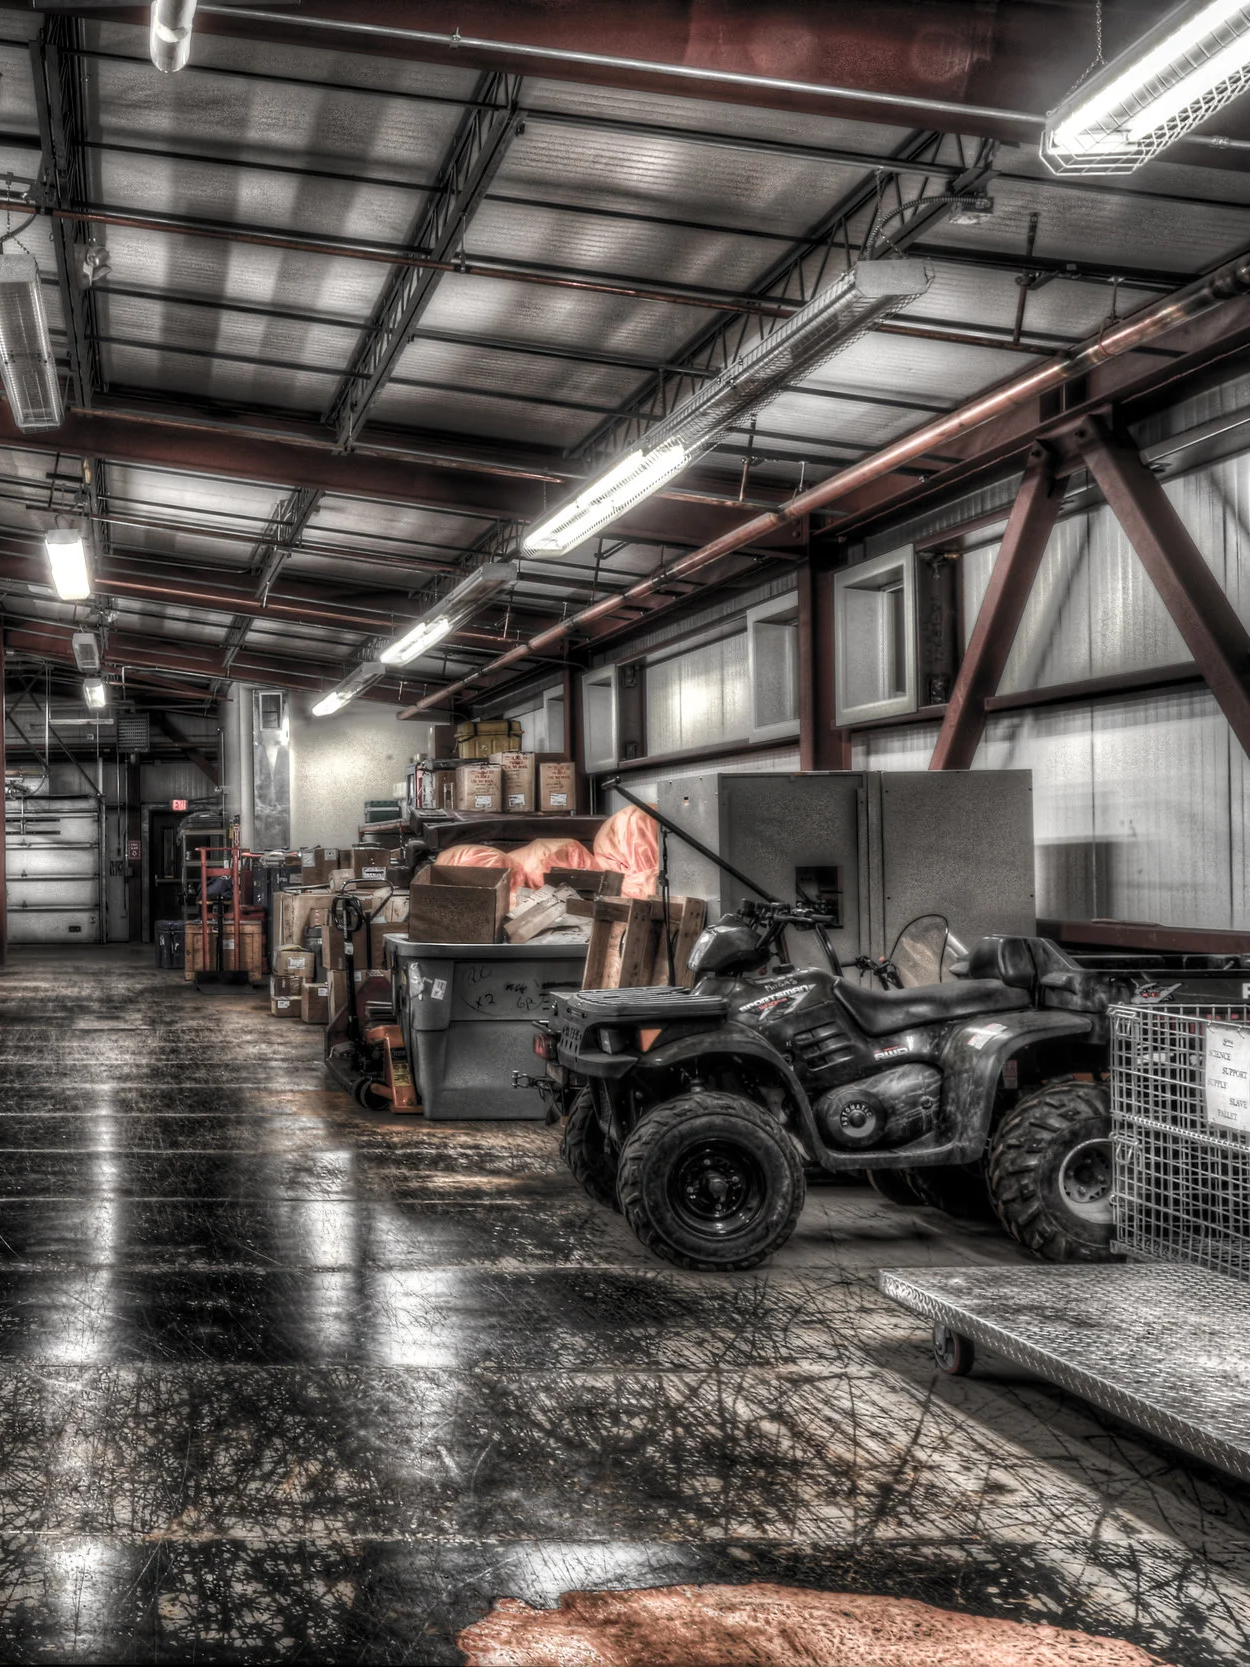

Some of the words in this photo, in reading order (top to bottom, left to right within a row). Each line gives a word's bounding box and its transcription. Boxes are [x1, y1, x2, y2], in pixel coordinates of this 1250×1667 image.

[739, 984, 810, 1012] SPORTSMAN
[1222, 1066, 1248, 1080] SUPPORT
[1208, 1078, 1228, 1090] SUPPLY
[1230, 1097, 1248, 1110] SLAVE
[1217, 1108, 1238, 1121] PALLET
